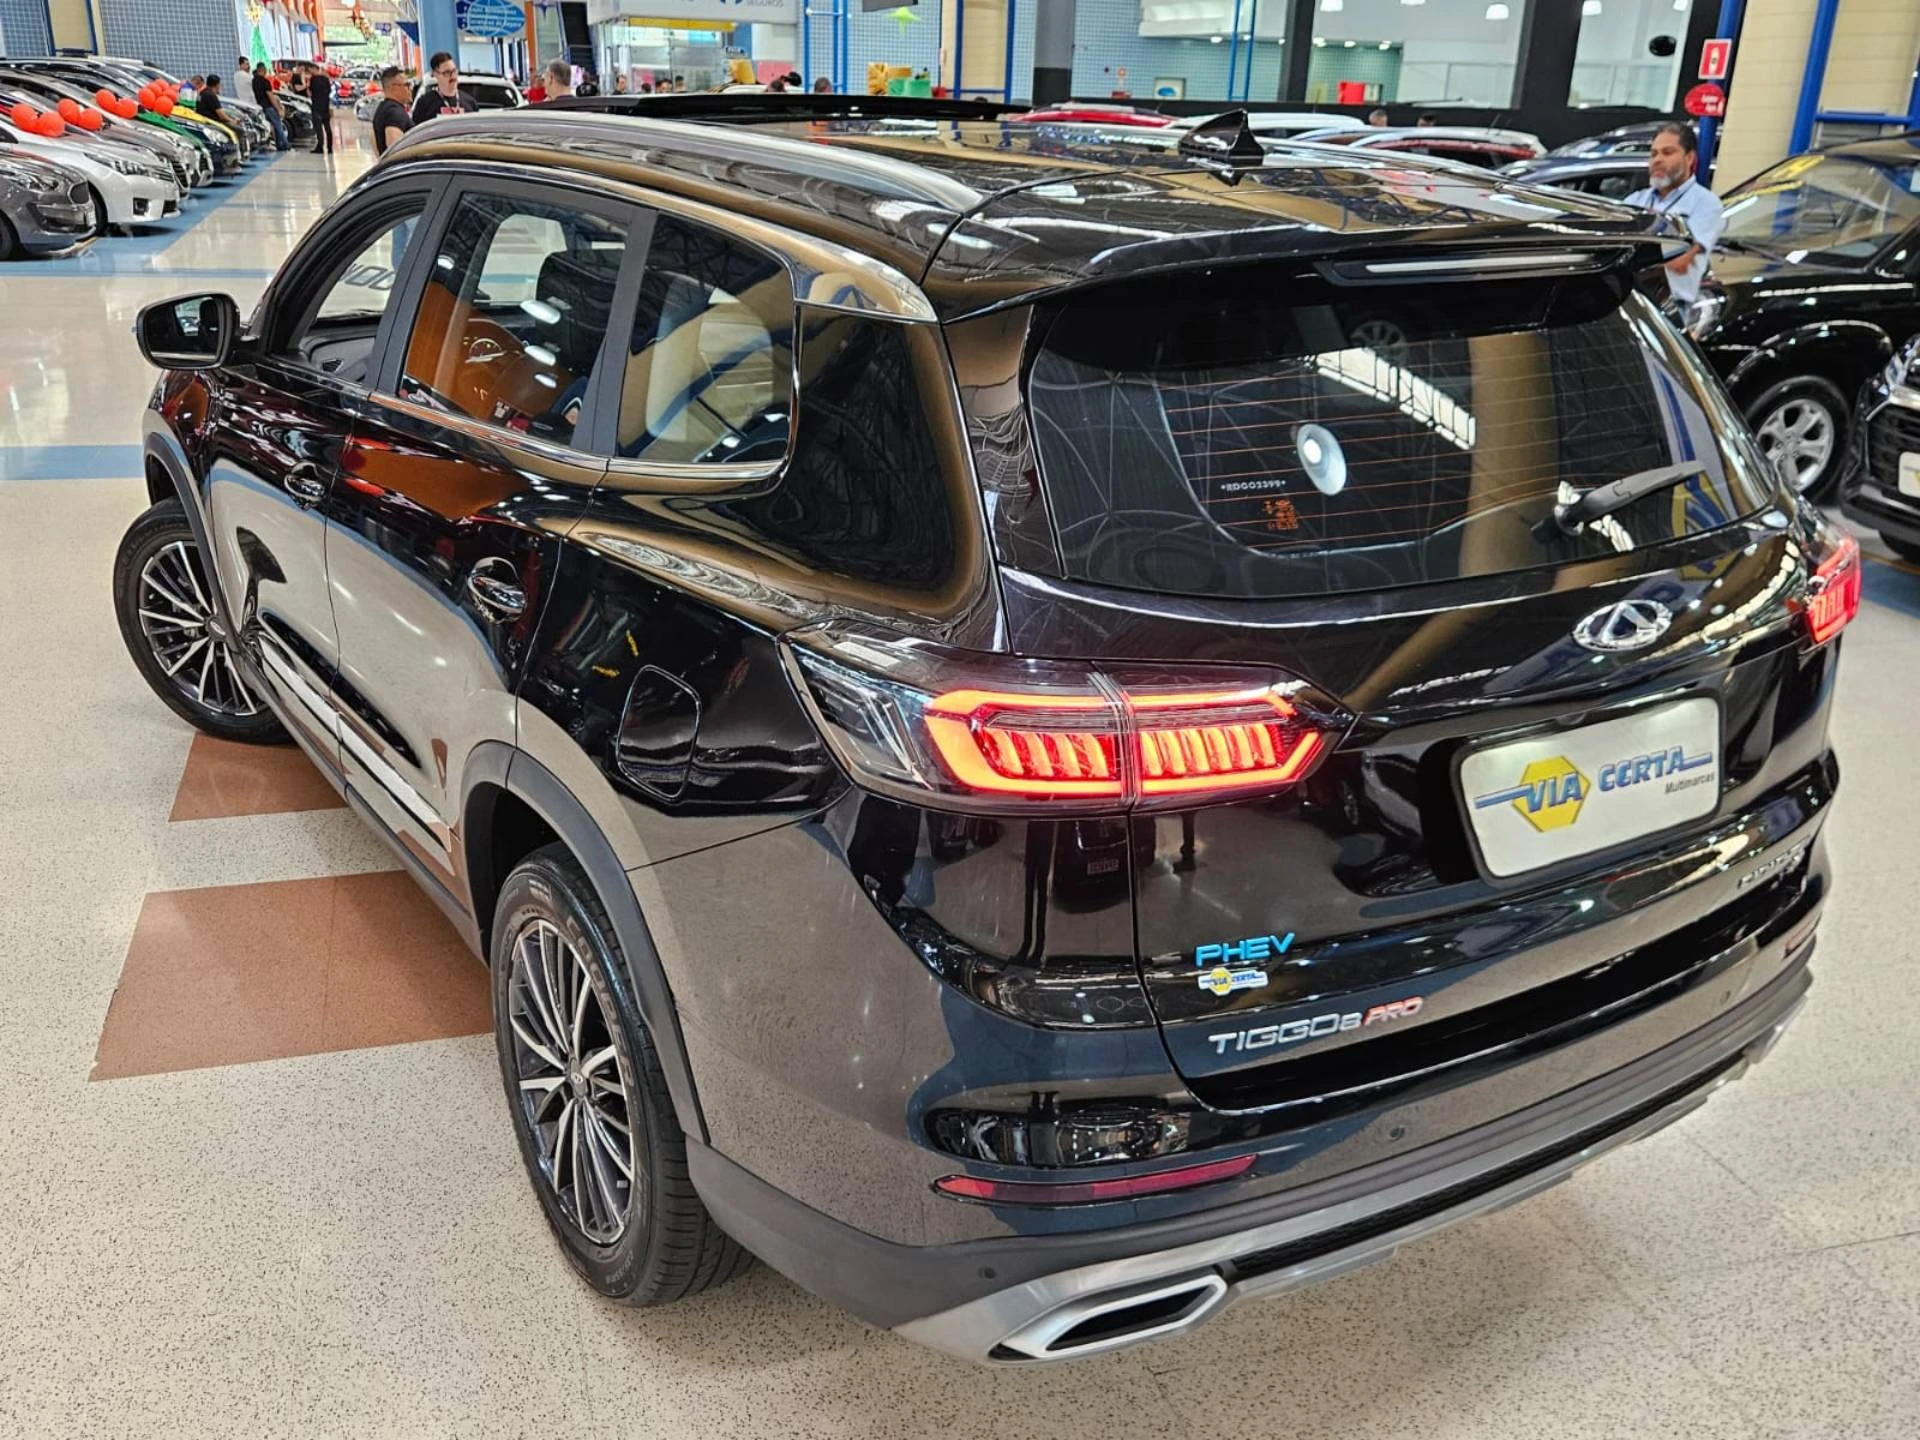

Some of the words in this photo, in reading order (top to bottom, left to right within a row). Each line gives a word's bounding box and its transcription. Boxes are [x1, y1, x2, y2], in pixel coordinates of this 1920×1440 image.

[1525, 772, 1584, 814] VIA
[1597, 745, 1686, 793] CERTA
[1663, 772, 1716, 795] Multimarcas
[1194, 932, 1296, 968] PHEV
[565, 914, 636, 1089] COOPER
[1362, 995, 1424, 1027] PRO
